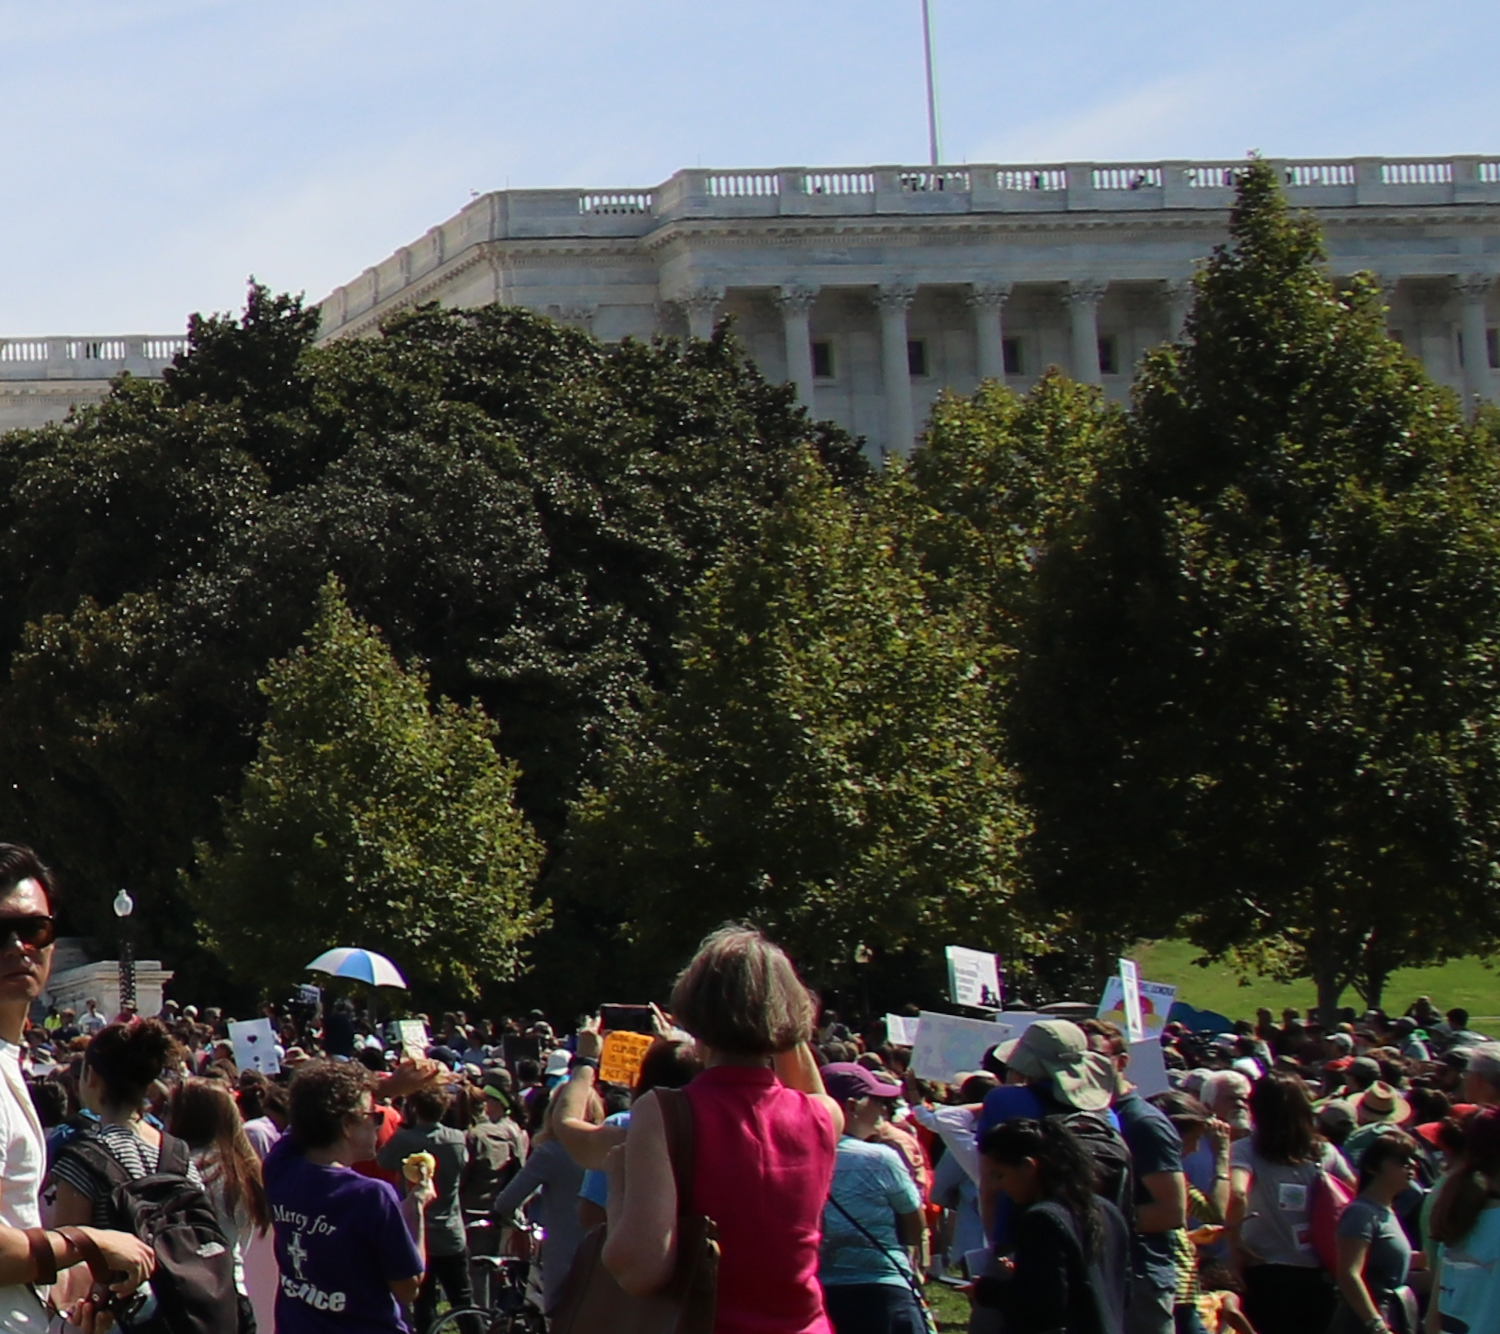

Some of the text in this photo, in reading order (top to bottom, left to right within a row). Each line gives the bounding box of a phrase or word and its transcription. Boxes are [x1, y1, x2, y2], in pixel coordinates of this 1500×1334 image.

[273, 1204, 337, 1235] Mercy for
[281, 1274, 346, 1312] stice
